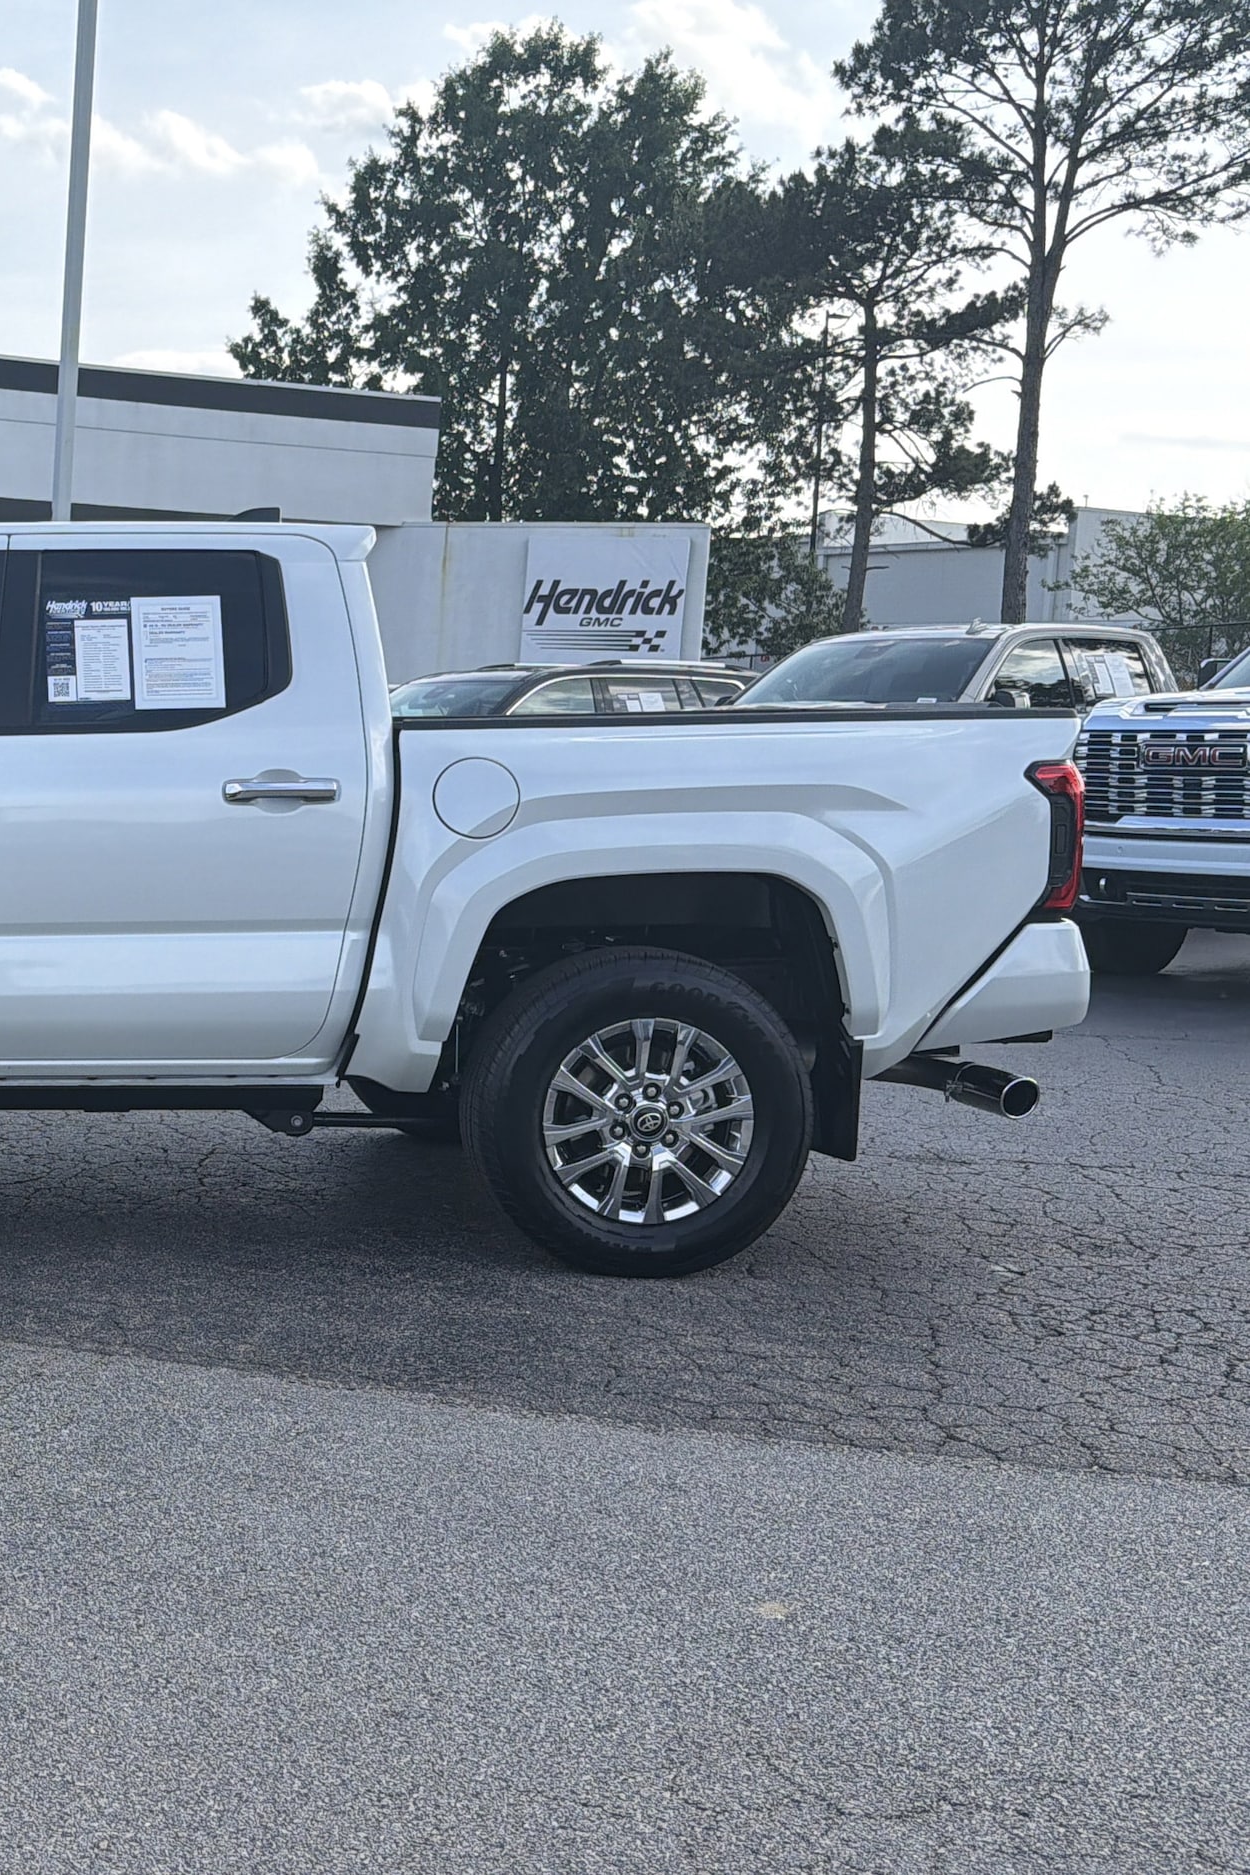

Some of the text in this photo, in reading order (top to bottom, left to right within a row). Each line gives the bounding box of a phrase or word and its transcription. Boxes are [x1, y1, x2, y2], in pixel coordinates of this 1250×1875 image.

[90, 601, 103, 612] 10
[523, 579, 685, 626] Hendrick
[579, 617, 623, 628] GMC
[1144, 746, 1243, 766] GMC
